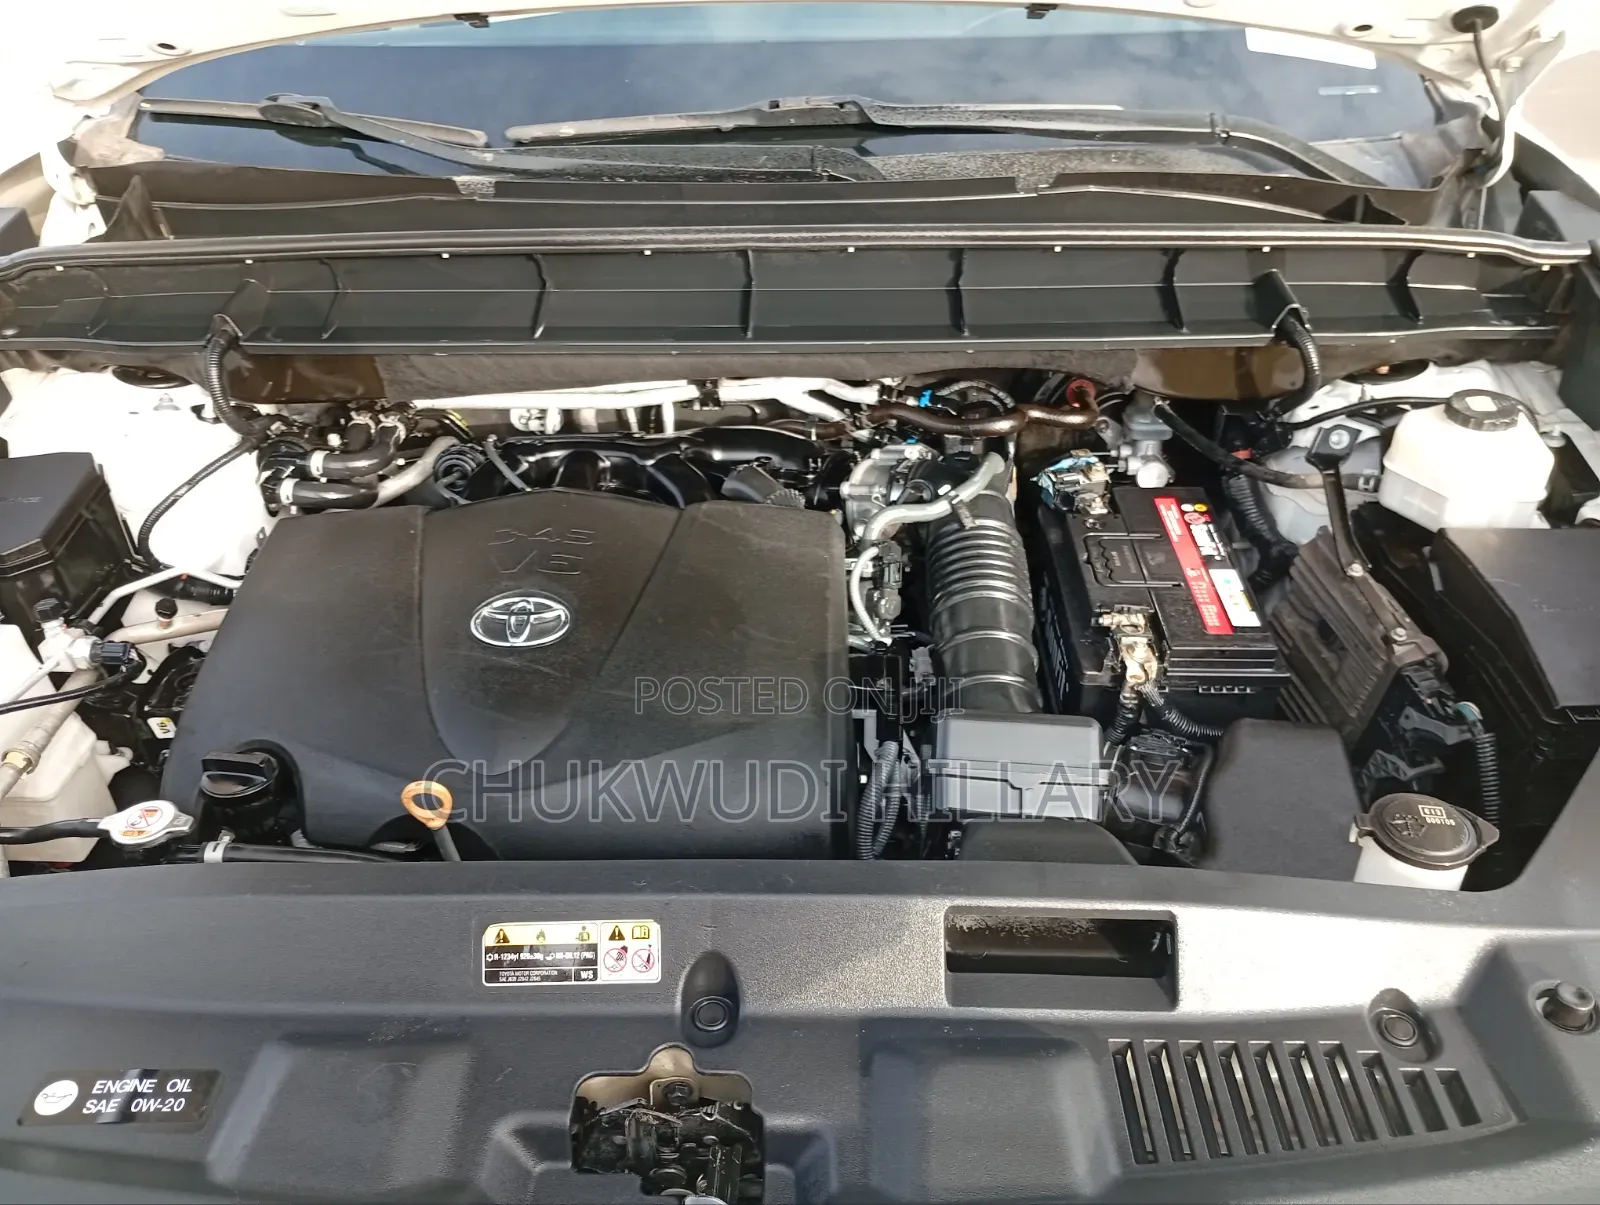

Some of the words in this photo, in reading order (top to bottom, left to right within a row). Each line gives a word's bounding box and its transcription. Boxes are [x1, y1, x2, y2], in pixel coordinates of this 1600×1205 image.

[580, 970, 594, 979] WS
[91, 1078, 158, 1094] ENGINE
[166, 1078, 193, 1093] OIL
[82, 1098, 121, 1114] SAE
[130, 1097, 186, 1112] 0W-20
